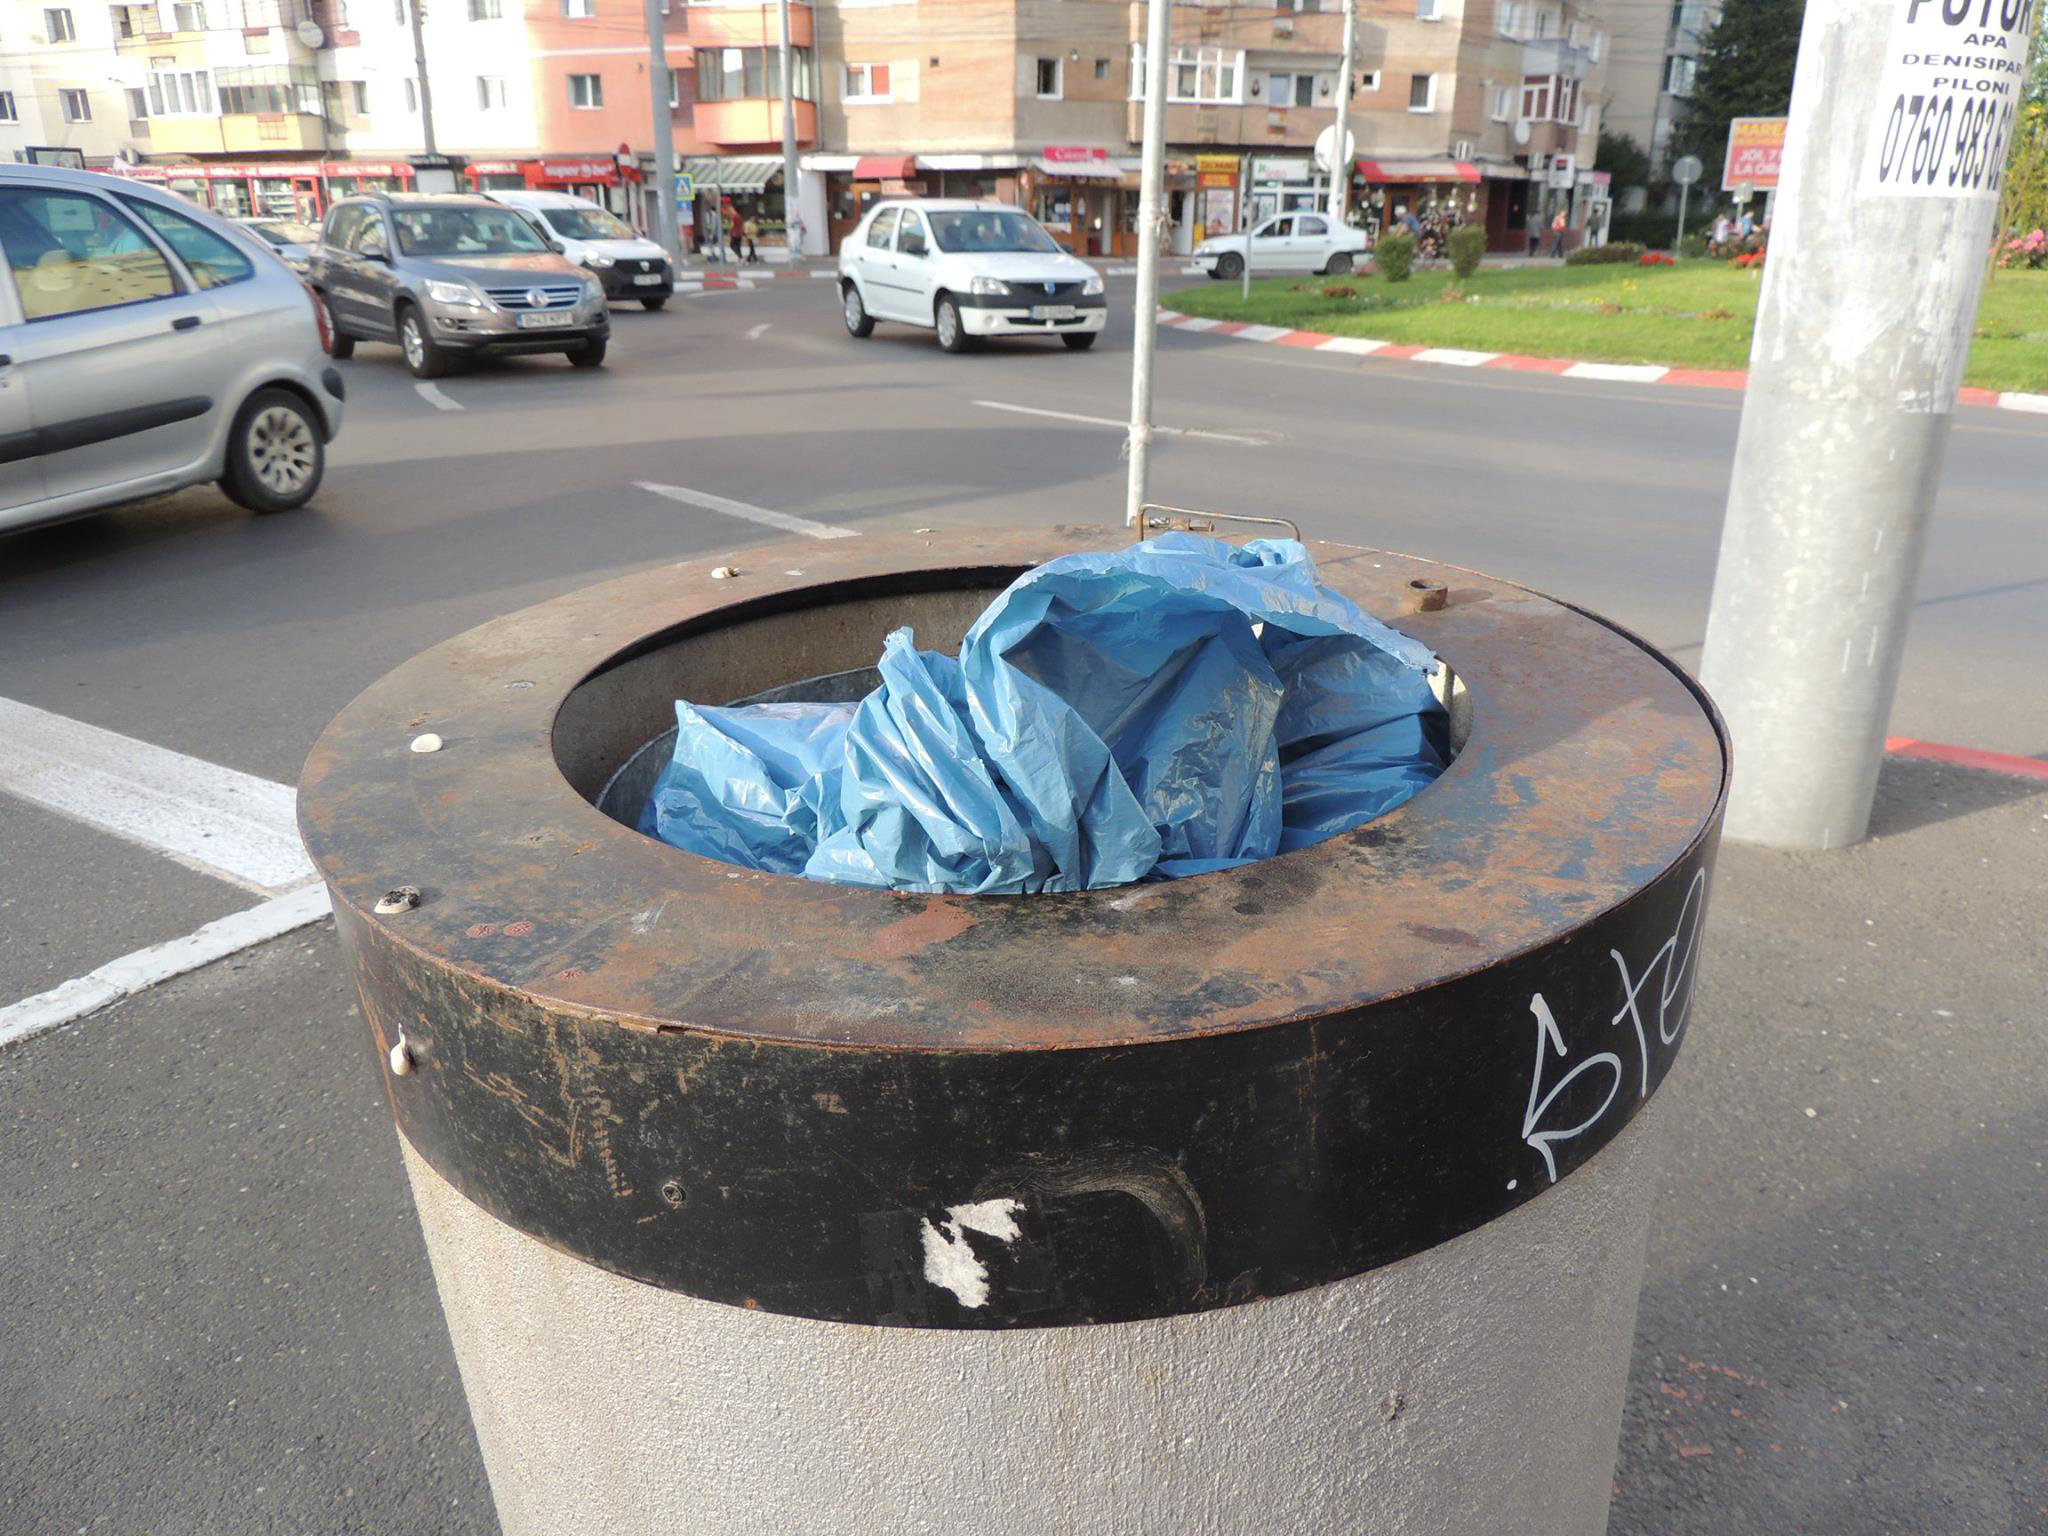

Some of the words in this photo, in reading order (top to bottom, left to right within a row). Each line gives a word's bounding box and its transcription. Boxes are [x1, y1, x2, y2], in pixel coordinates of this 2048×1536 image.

[1963, 33, 2007, 48] APA
[1933, 77, 2010, 95] PILONI
[1880, 94, 1953, 185] 0760
